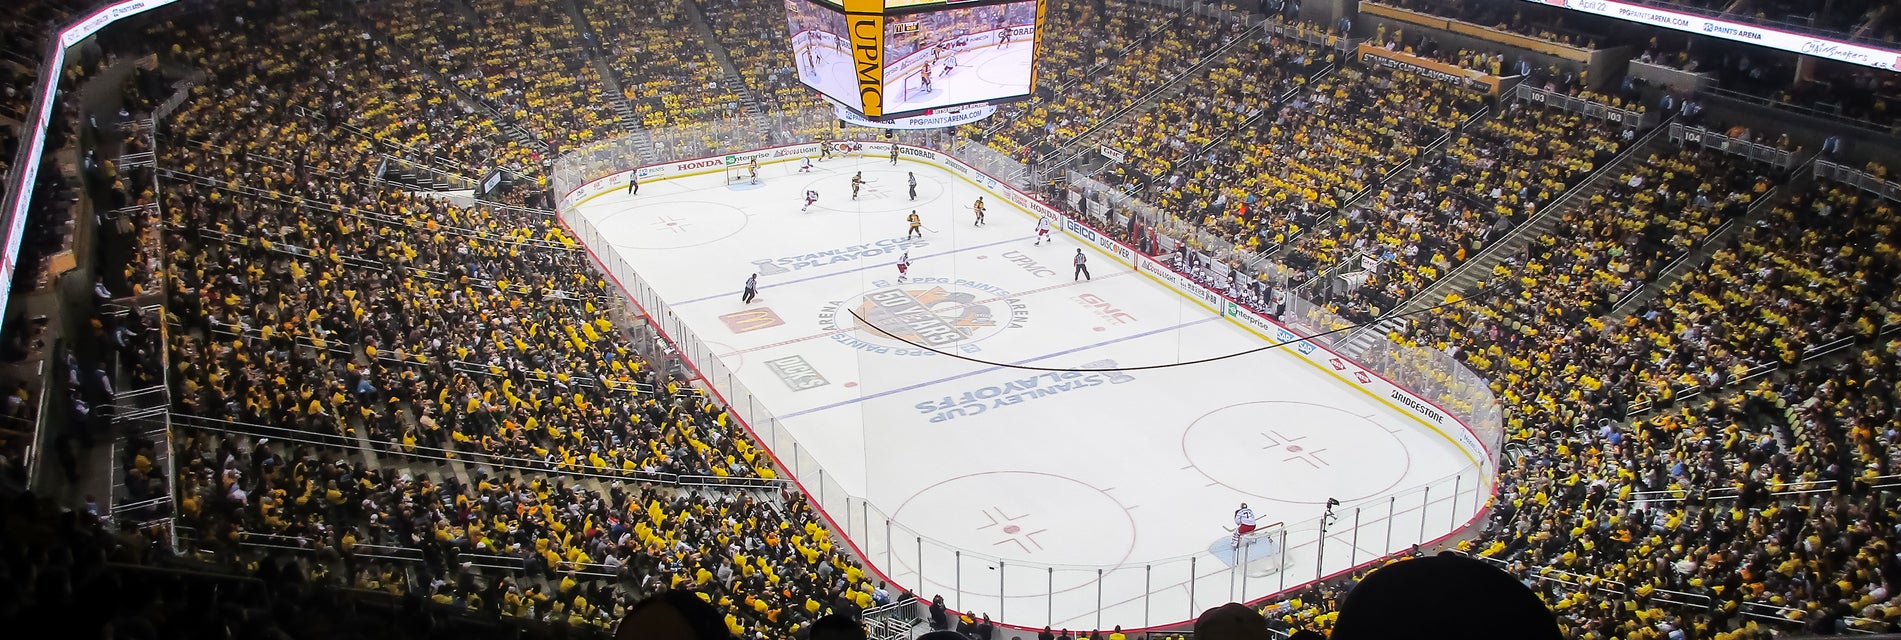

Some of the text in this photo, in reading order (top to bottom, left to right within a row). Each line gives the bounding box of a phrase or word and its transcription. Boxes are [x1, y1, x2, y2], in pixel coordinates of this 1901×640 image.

[1597, 2, 1606, 11] 22
[1619, 8, 1688, 27] PPGPAINTSARENA.COM
[1713, 25, 1738, 36] PAINTS
[1738, 31, 1762, 40] ARENA
[854, 19, 881, 107] UPMC
[1416, 67, 1461, 85] PLAYOFFS
[1531, 92, 1545, 103] 103
[909, 110, 982, 126] PPGPAINTSARENA.COM
[1607, 111, 1622, 122] 103
[1685, 131, 1700, 143] 104
[900, 148, 936, 160] GATORADE
[1103, 147, 1120, 158] GNC
[678, 159, 723, 171] HONDA
[1030, 202, 1059, 221] HONDA
[1067, 220, 1096, 242] GEICO
[777, 242, 871, 266] STANLEY
[792, 239, 930, 271] PLAYOFFS
[1100, 238, 1130, 260] DISCOVER
[1002, 250, 1056, 278] UPMC
[912, 277, 1029, 330] PPG PAINTS ARENA
[1079, 293, 1137, 324] GNC
[818, 300, 843, 331] ARENA
[873, 290, 961, 343] 50 YEARS
[830, 333, 891, 355] PAINTS
[1277, 331, 1291, 343] SAP
[1298, 341, 1313, 354] SAP
[915, 369, 1083, 414] PLAYOFFS
[929, 374, 1104, 424] STANLEY CUP
[1391, 389, 1444, 425] BRIDGESTONE
